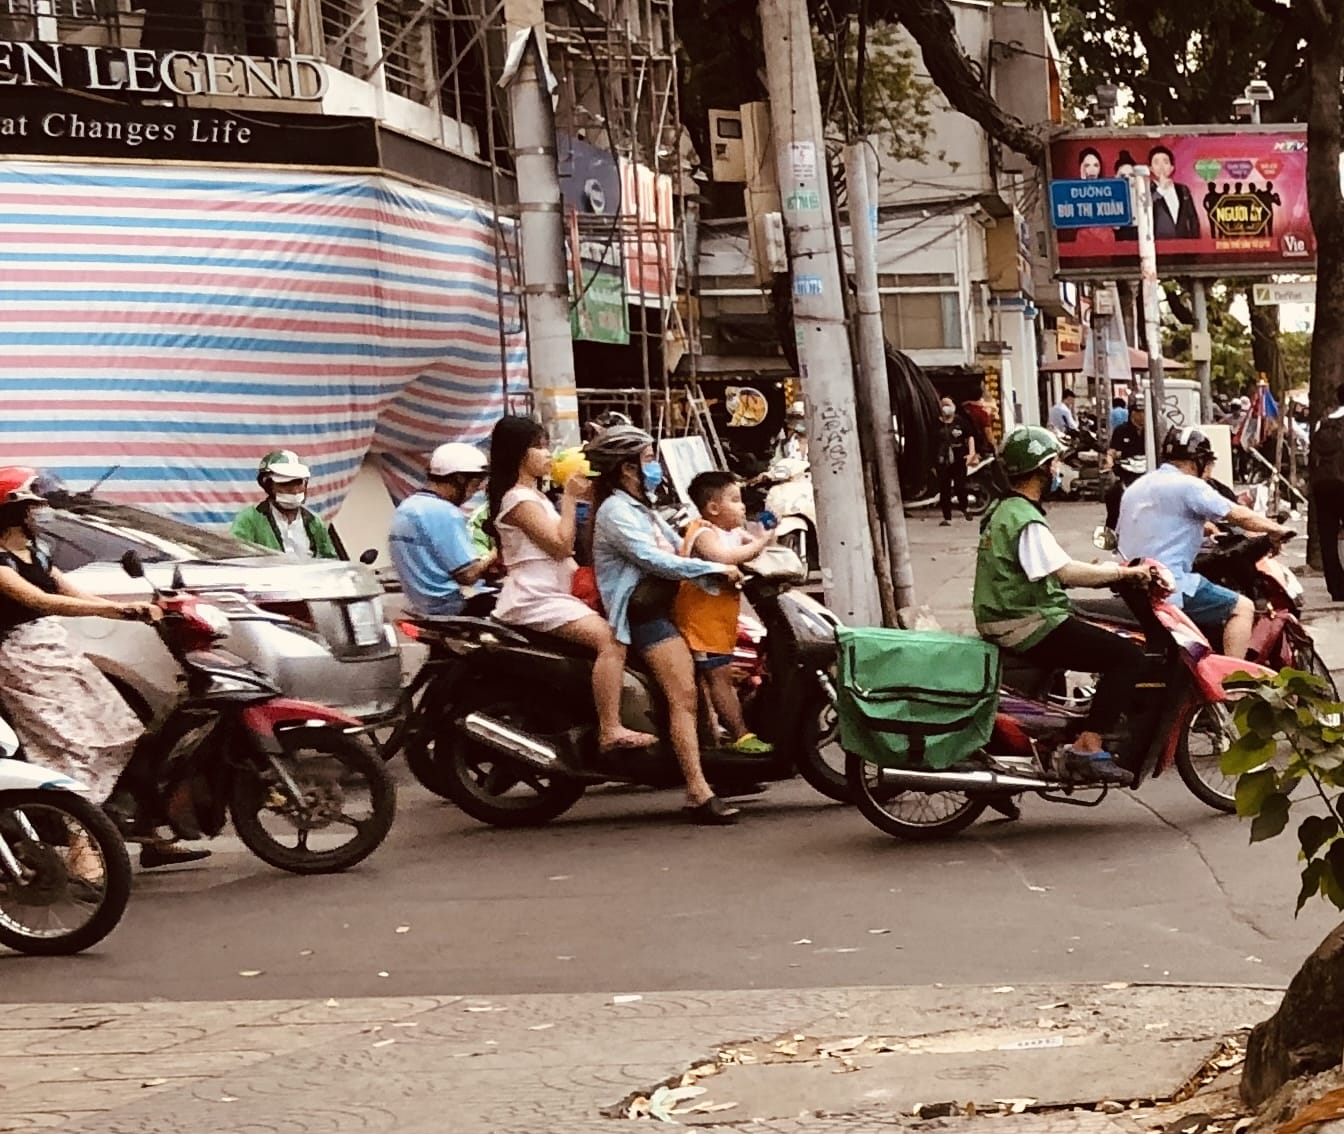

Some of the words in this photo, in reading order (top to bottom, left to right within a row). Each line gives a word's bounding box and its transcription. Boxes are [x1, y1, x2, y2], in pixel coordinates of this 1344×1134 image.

[83, 45, 329, 101] LEGEND
[43, 113, 176, 146] Changes
[191, 119, 251, 144] Life
[1096, 199, 1125, 216] XUÂN
